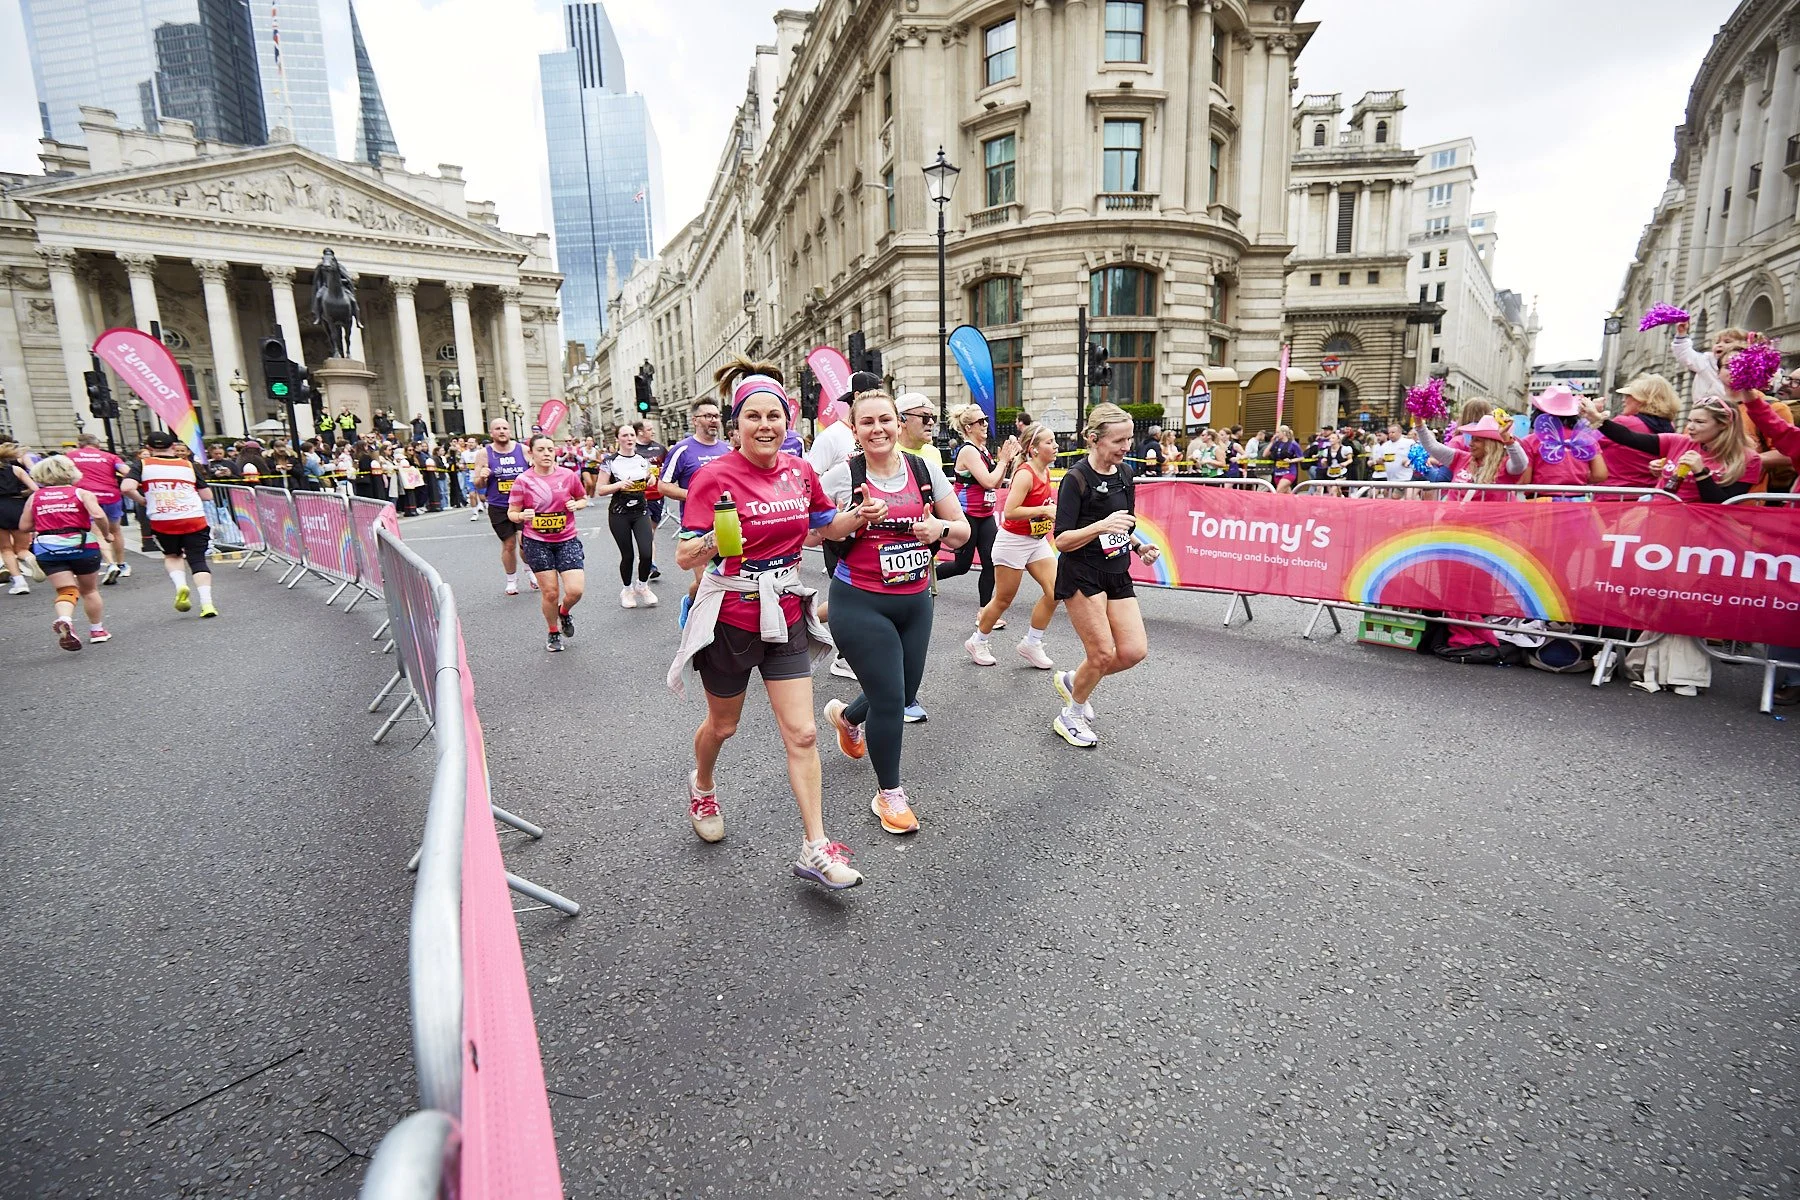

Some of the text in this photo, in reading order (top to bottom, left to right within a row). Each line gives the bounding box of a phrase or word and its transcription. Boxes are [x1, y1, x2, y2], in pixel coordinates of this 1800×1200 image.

[499, 456, 516, 465] ROB
[148, 481, 174, 492] JUST
[746, 495, 811, 516] Tommy's
[535, 518, 565, 528] 12074
[761, 517, 787, 526] pregnancy
[1188, 511, 1332, 553] Tommy's
[884, 544, 903, 552] SHARA
[768, 558, 784, 567] JULIE
[885, 550, 929, 571] 10105
[1186, 545, 1328, 571] The pregnancy and baby charity
[1602, 534, 1800, 584] Tomm
[1595, 581, 1625, 594] The
[1629, 585, 1723, 606] pregnancy
[1728, 595, 1766, 608] and
